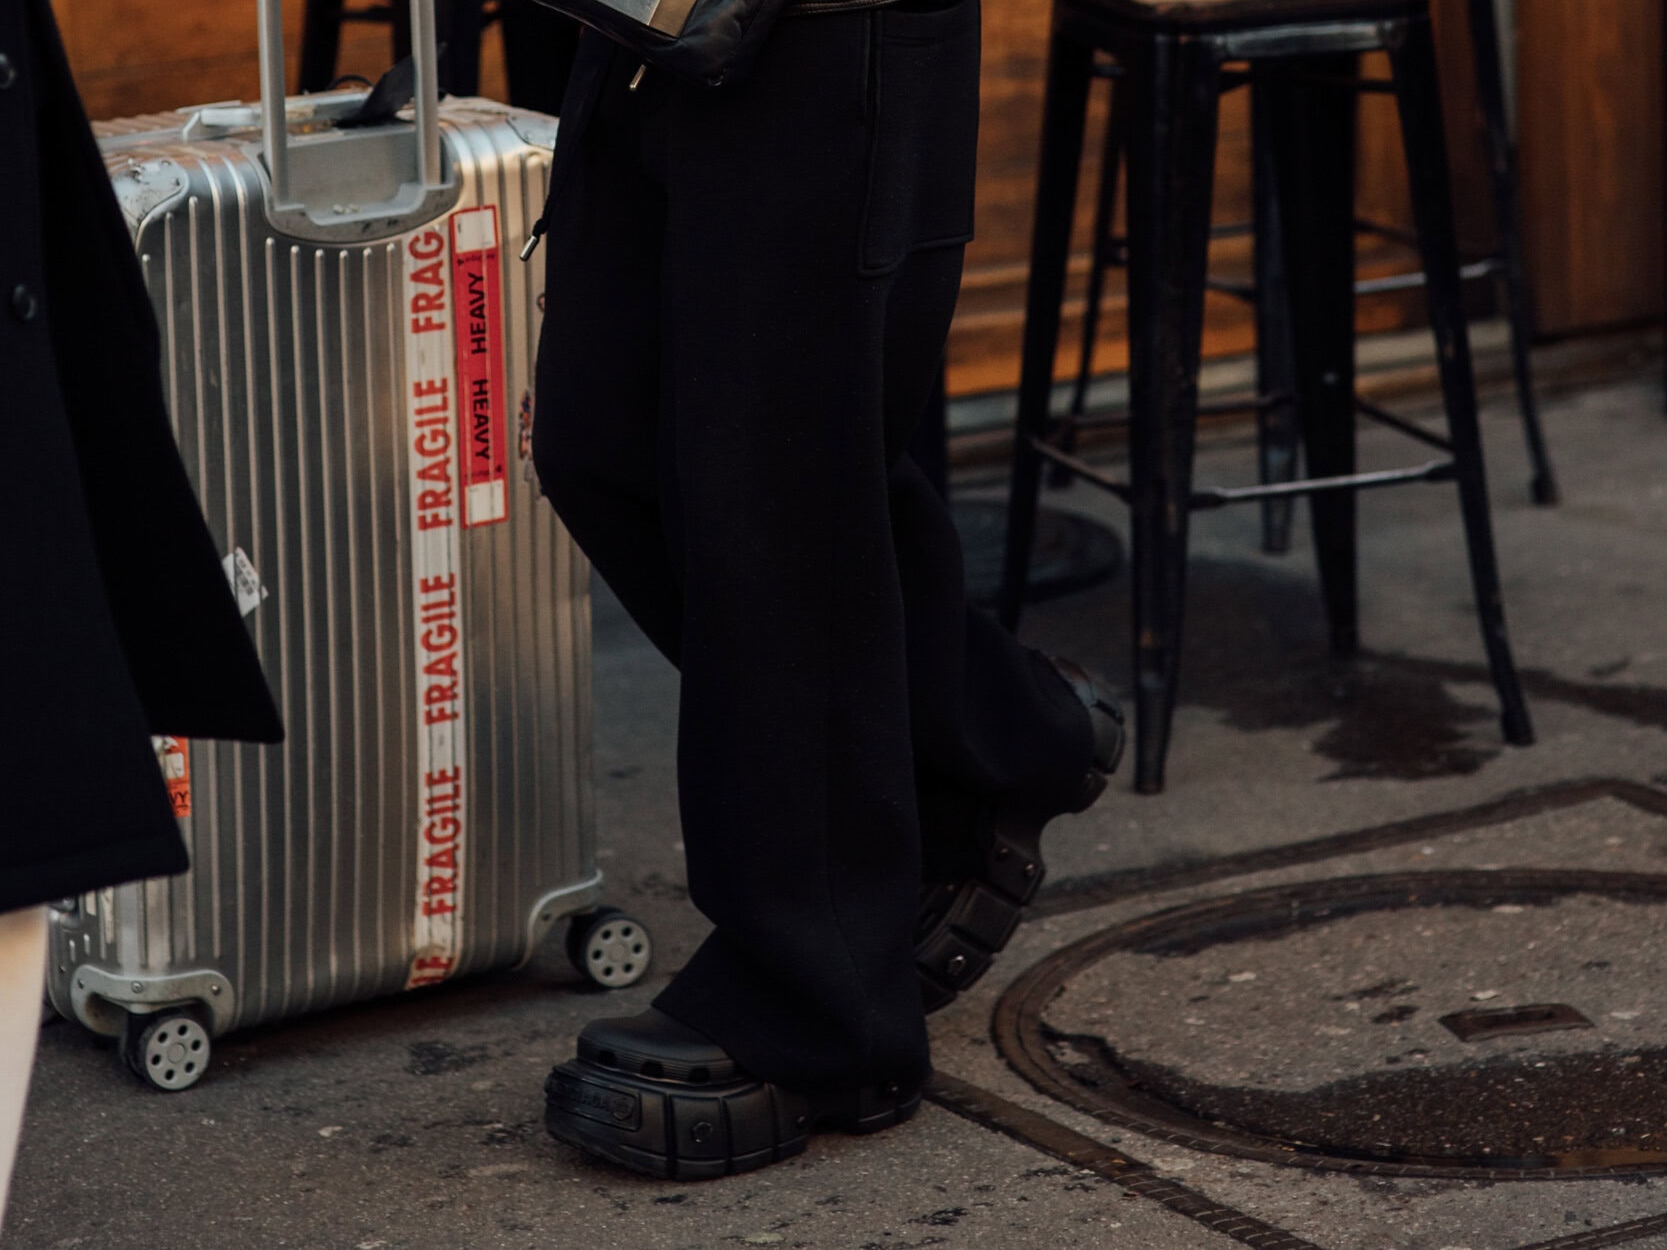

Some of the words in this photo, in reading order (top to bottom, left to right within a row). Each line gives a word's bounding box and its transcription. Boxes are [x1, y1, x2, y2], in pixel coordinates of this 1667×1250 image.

[408, 230, 447, 335] FRAG
[467, 272, 488, 354] HEAVY
[413, 377, 454, 531] FRAGILE
[472, 378, 491, 460] HEAVY
[419, 574, 459, 726] FRAGILE
[422, 767, 461, 918] FRAGILE
